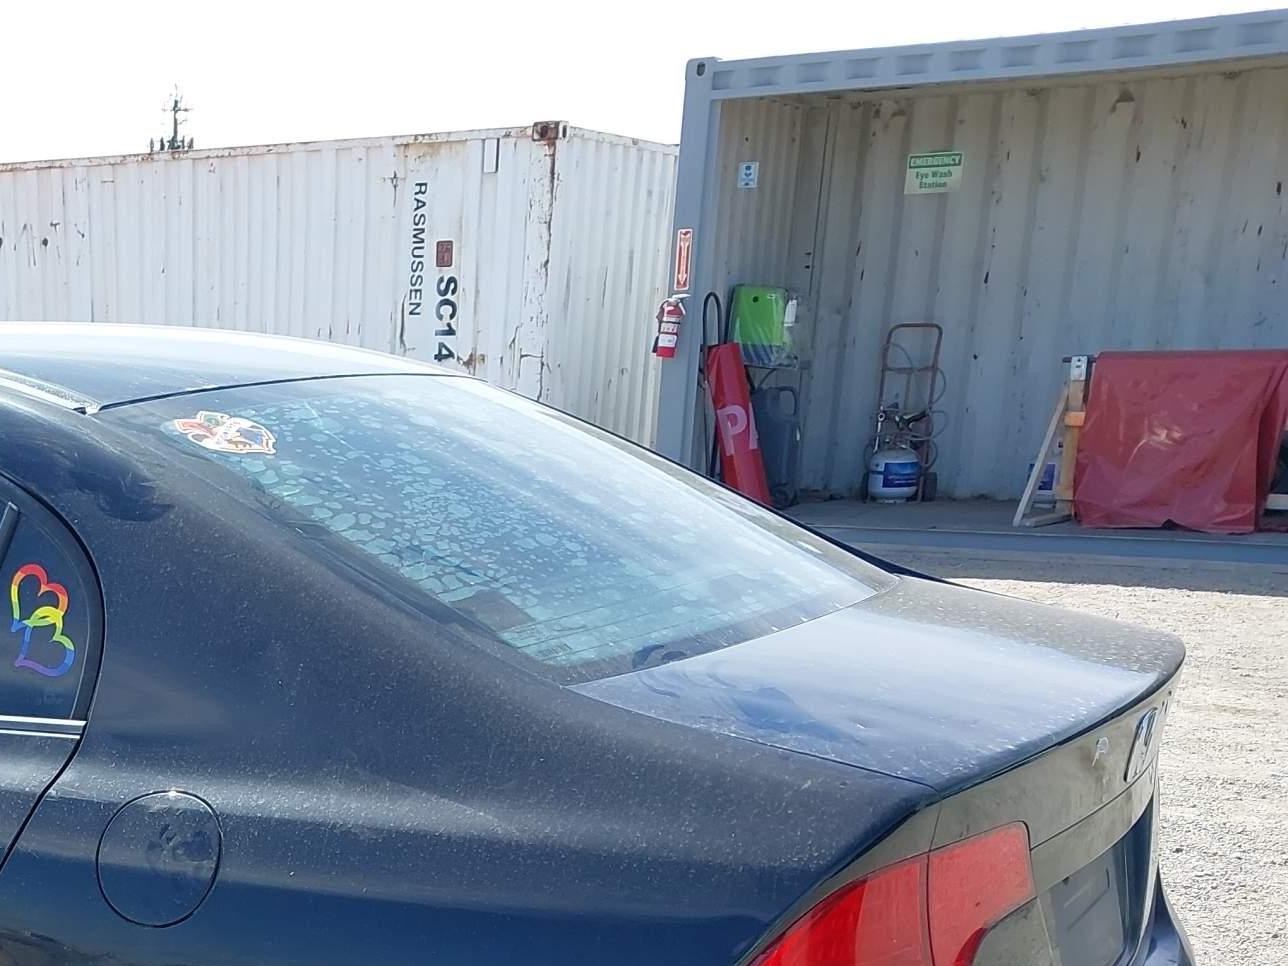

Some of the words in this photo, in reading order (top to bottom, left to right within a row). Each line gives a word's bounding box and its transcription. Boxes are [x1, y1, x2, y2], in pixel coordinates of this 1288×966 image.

[911, 156, 961, 167] EMERGENCY
[915, 171, 930, 181] Eye
[931, 169, 953, 178] Wash
[409, 182, 428, 316] RASMUSSEN
[434, 275, 458, 362] SC14
